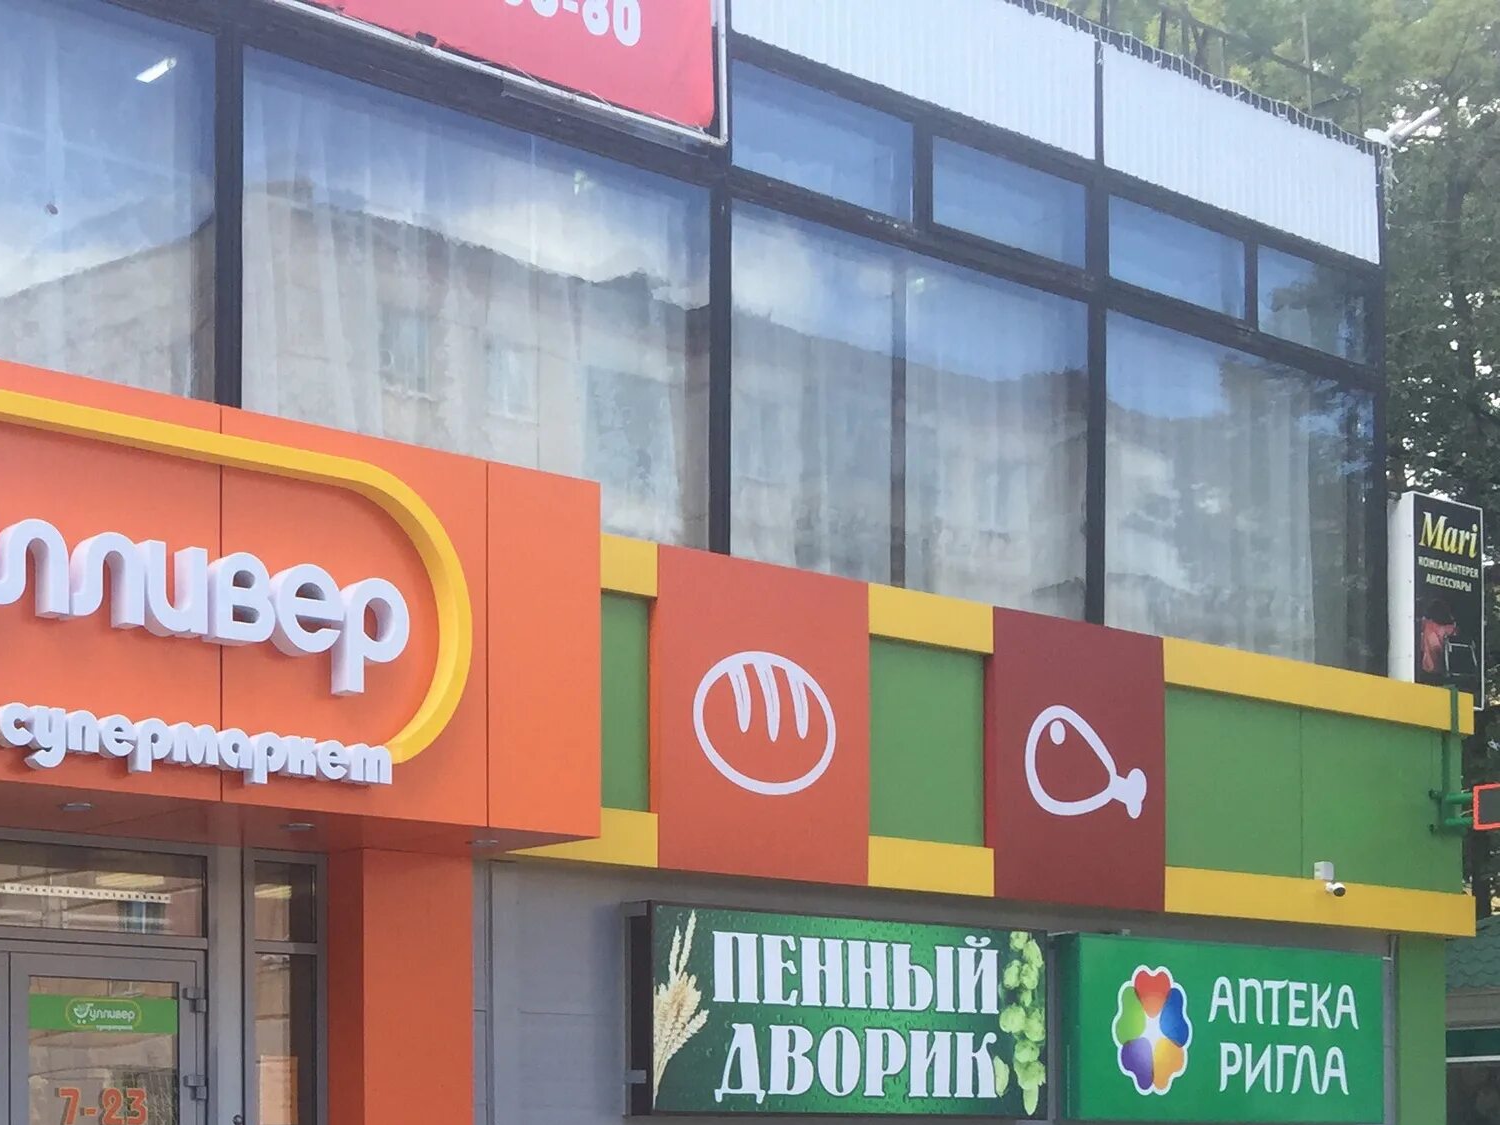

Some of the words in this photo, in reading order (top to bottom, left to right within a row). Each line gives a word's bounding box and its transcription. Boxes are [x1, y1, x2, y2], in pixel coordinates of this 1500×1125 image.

[1418, 511, 1478, 559] Mari
[1425, 573, 1472, 592] АКСЕССУАРЫ
[712, 930, 1001, 1016] ПЕННЫЙ
[1208, 974, 1359, 1031] АПТЕКА
[713, 1022, 1004, 1104] ДВОРИК
[1219, 1043, 1350, 1097] РИГЛА
